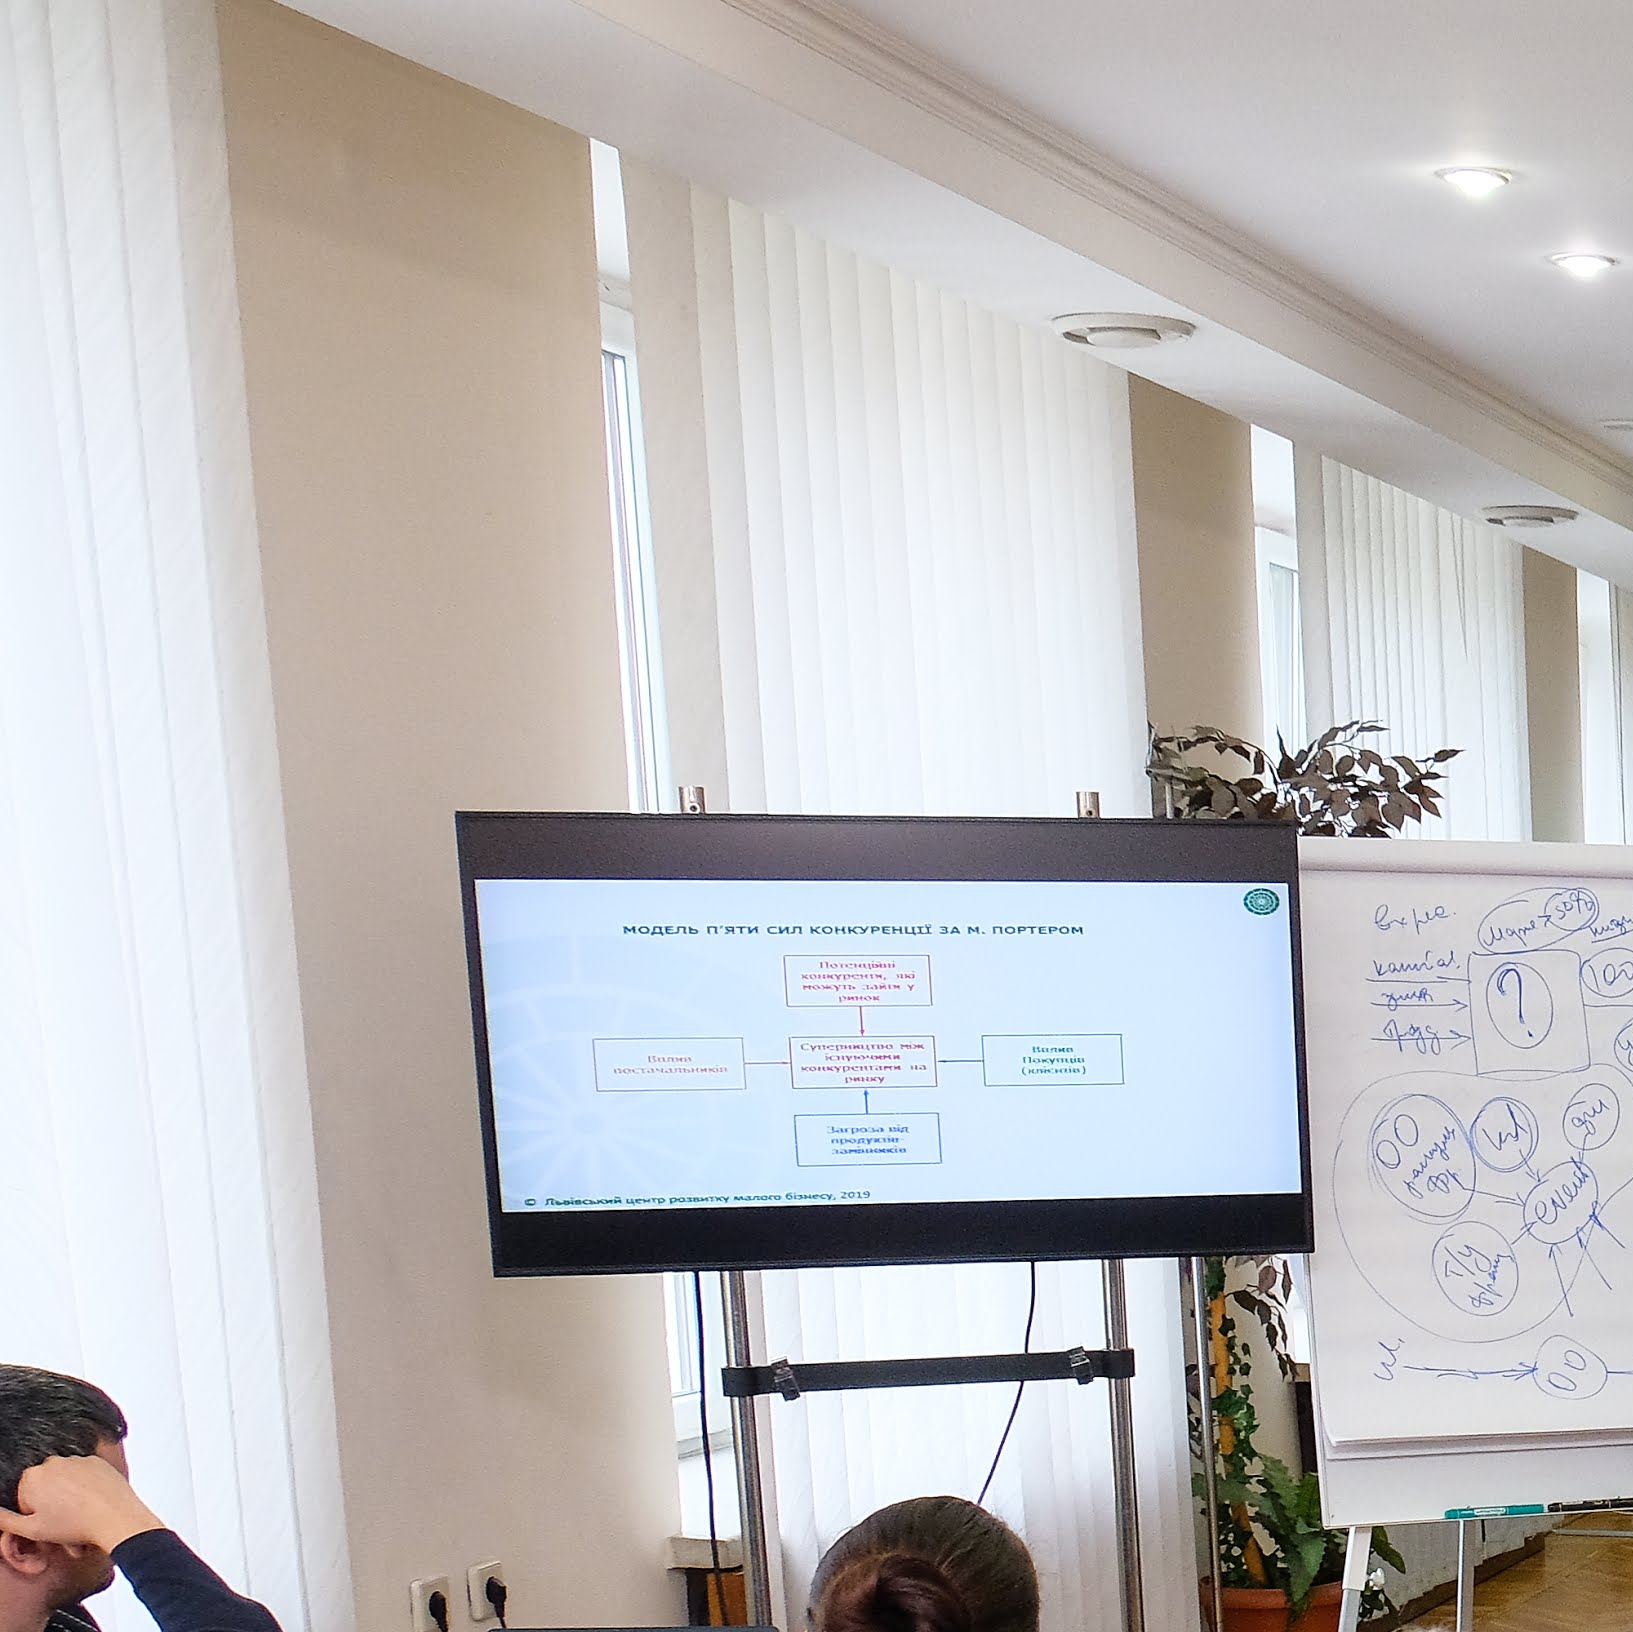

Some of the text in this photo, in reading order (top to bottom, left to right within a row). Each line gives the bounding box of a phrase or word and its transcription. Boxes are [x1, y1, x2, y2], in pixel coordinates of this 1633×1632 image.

[623, 925, 699, 936] МОДЕЛЬ
[767, 925, 803, 936] СИЛ
[809, 924, 932, 936] КОНКУРЕНЦІЇ
[939, 925, 961, 935] ЗА
[967, 925, 986, 935] М.
[993, 925, 1084, 935] ПОРТЕРОМ
[840, 1190, 871, 1199] 2019
